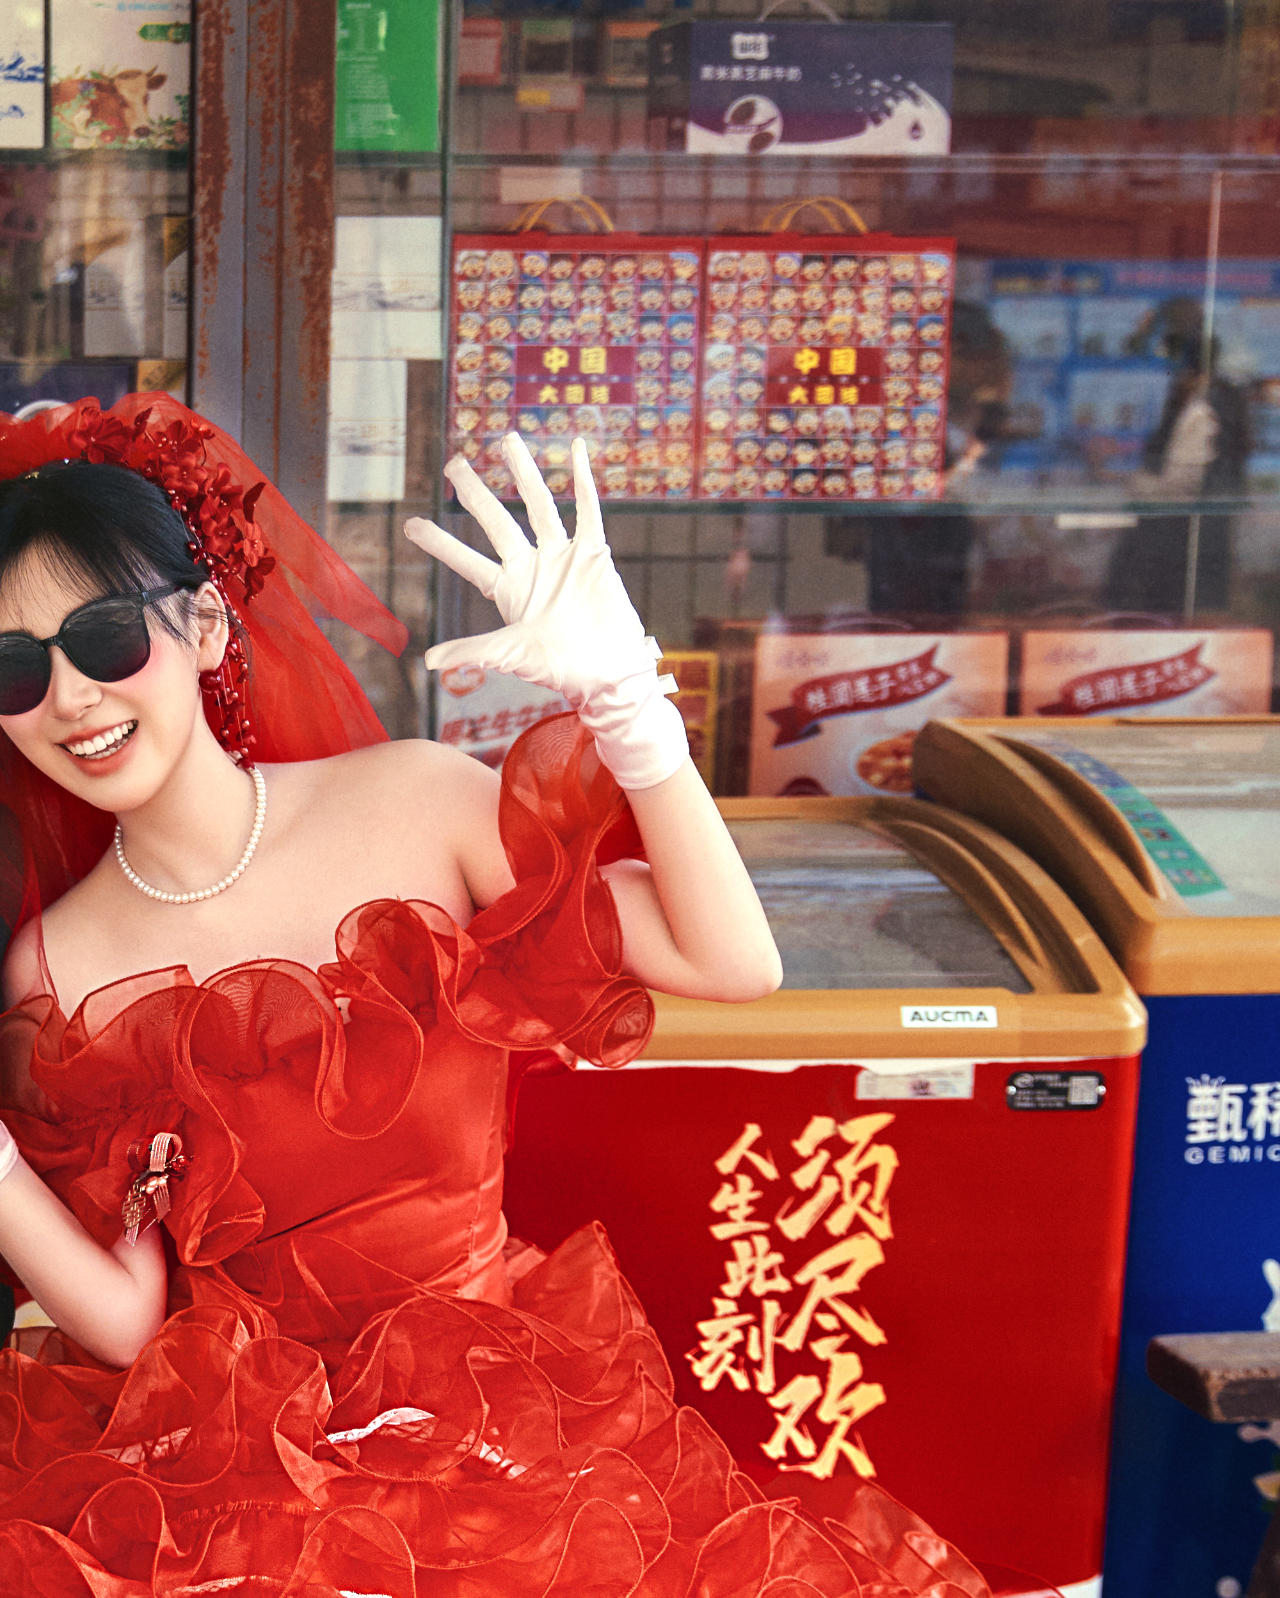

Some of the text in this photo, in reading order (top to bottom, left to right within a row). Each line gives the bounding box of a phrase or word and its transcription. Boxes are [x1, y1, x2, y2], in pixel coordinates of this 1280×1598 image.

[543, 346, 607, 374] 中国
[794, 347, 856, 375] 中国
[910, 1010, 989, 1023] AUCMA
[685, 1122, 793, 1394] 人生此刻
[759, 1112, 900, 1480] 须尽欢
